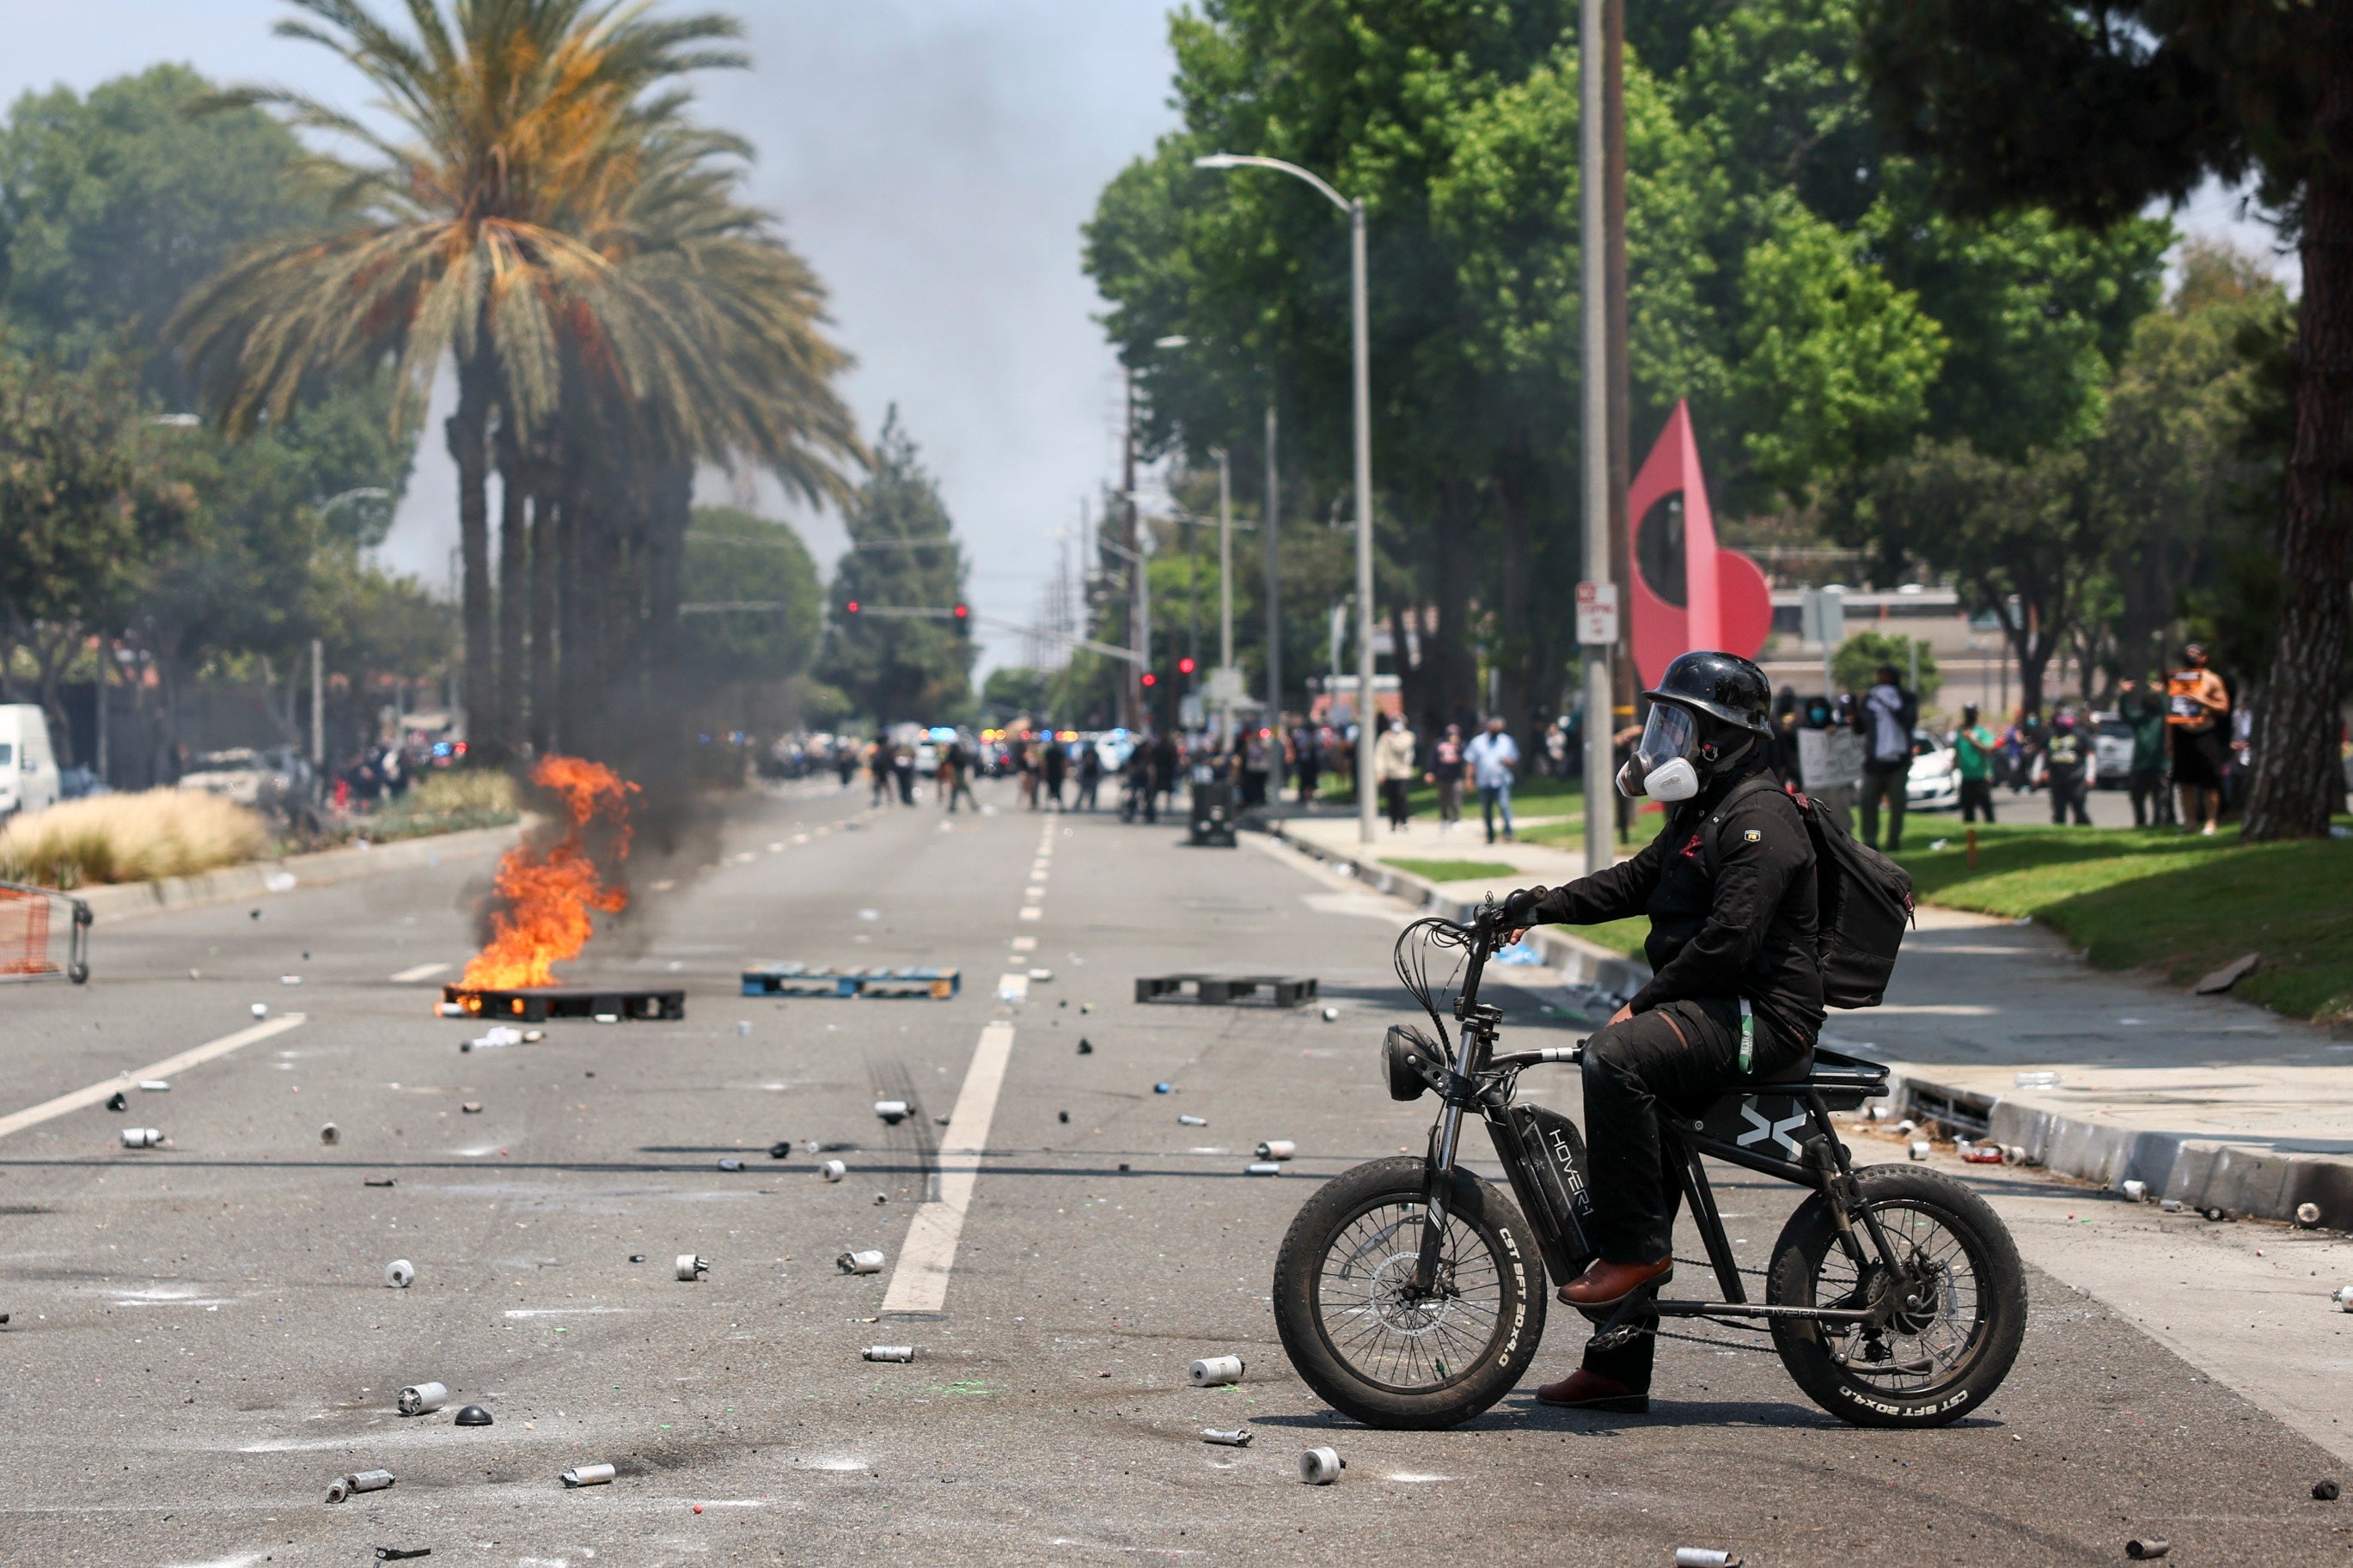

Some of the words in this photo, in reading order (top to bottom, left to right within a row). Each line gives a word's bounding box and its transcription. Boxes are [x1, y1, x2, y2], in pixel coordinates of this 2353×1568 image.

[1549, 1129, 1594, 1216] HOVER-1
[1499, 1228, 1520, 1259] CST
[1513, 1263, 1526, 1299] BFT
[1902, 1405, 1937, 1416] BFT
[1941, 1389, 1969, 1412] CST
